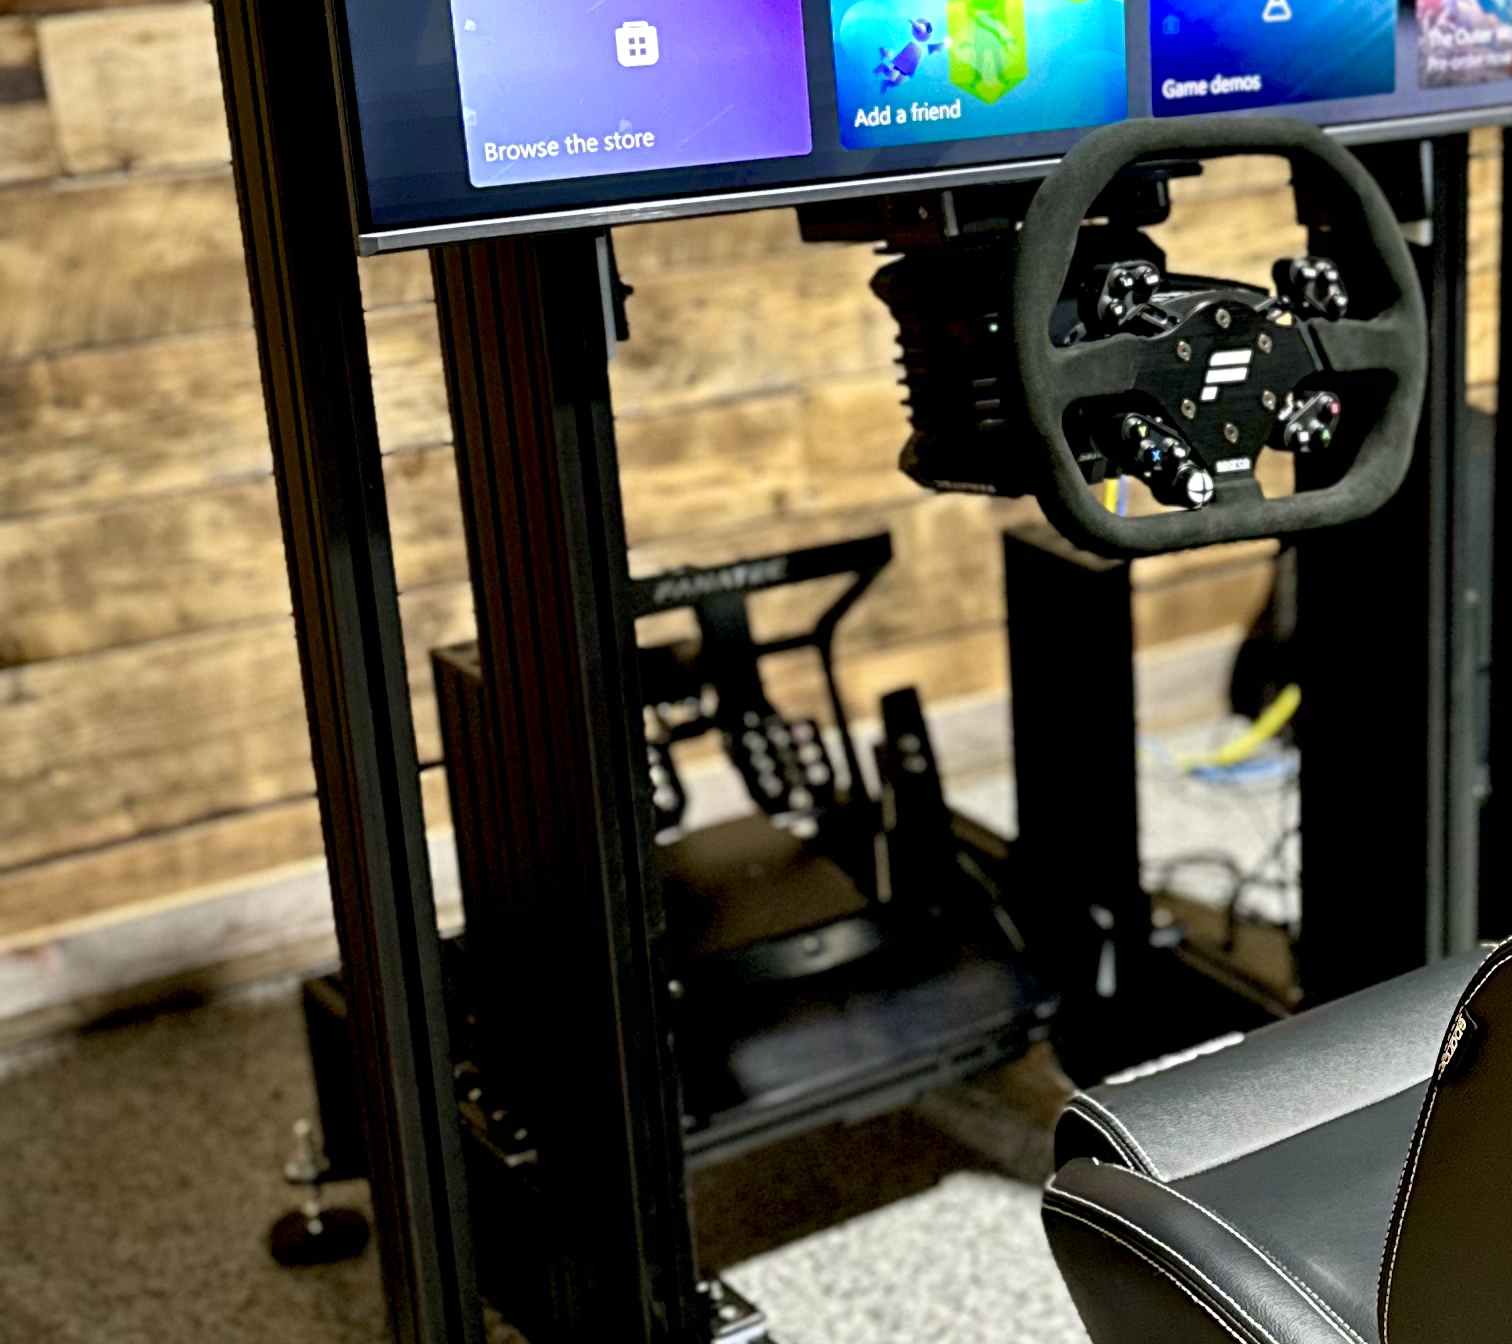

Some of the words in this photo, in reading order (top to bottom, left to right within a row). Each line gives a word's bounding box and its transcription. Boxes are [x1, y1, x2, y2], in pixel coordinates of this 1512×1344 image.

[1162, 78, 1208, 100] Game
[1210, 73, 1262, 95] demos
[855, 106, 891, 128] Add
[896, 108, 907, 125] a
[911, 98, 962, 123] friend
[484, 141, 560, 163] Browse
[564, 132, 598, 155] the
[603, 130, 656, 152] store
